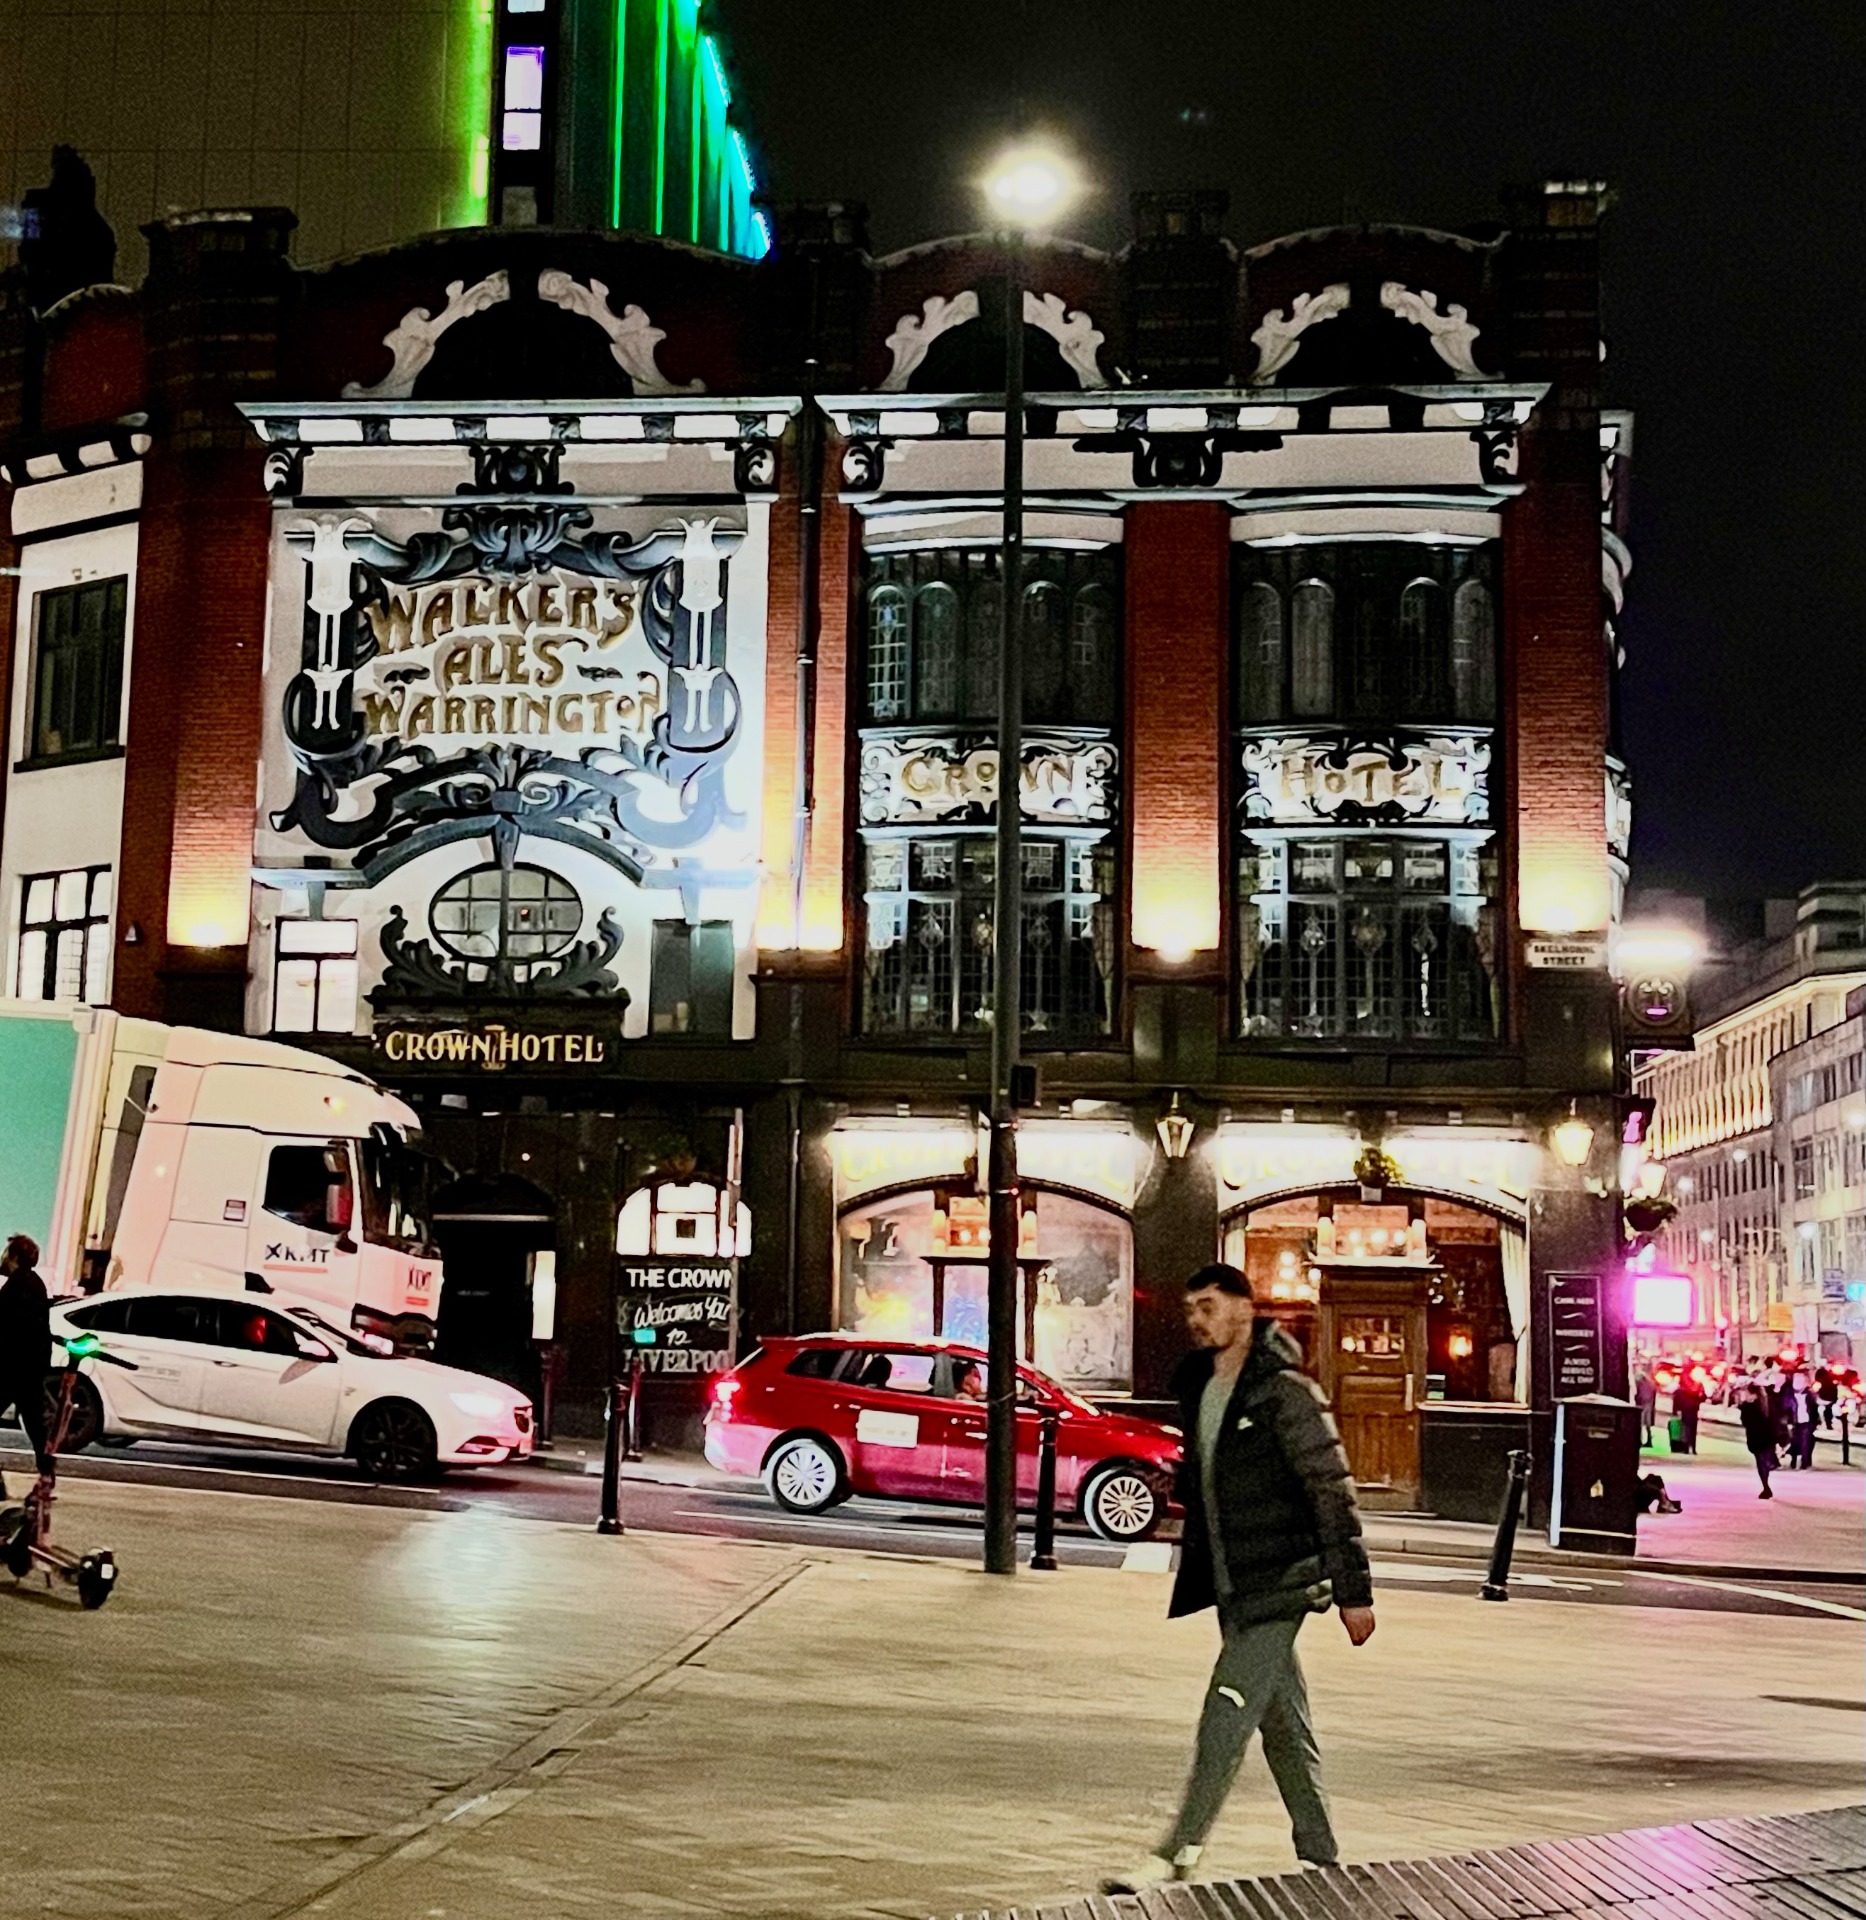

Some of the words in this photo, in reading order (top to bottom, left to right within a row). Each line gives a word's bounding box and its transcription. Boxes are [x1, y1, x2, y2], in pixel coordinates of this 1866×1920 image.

[436, 634, 589, 697] ALES
[357, 671, 660, 740] WARRINGTON
[1281, 755, 1462, 802] HOTEL
[1543, 956, 1586, 965] STREET
[385, 1030, 491, 1061] CROWN
[500, 1031, 605, 1063] HOTEL
[626, 1268, 665, 1288] THE
[634, 1301, 704, 1329] Welcomes
